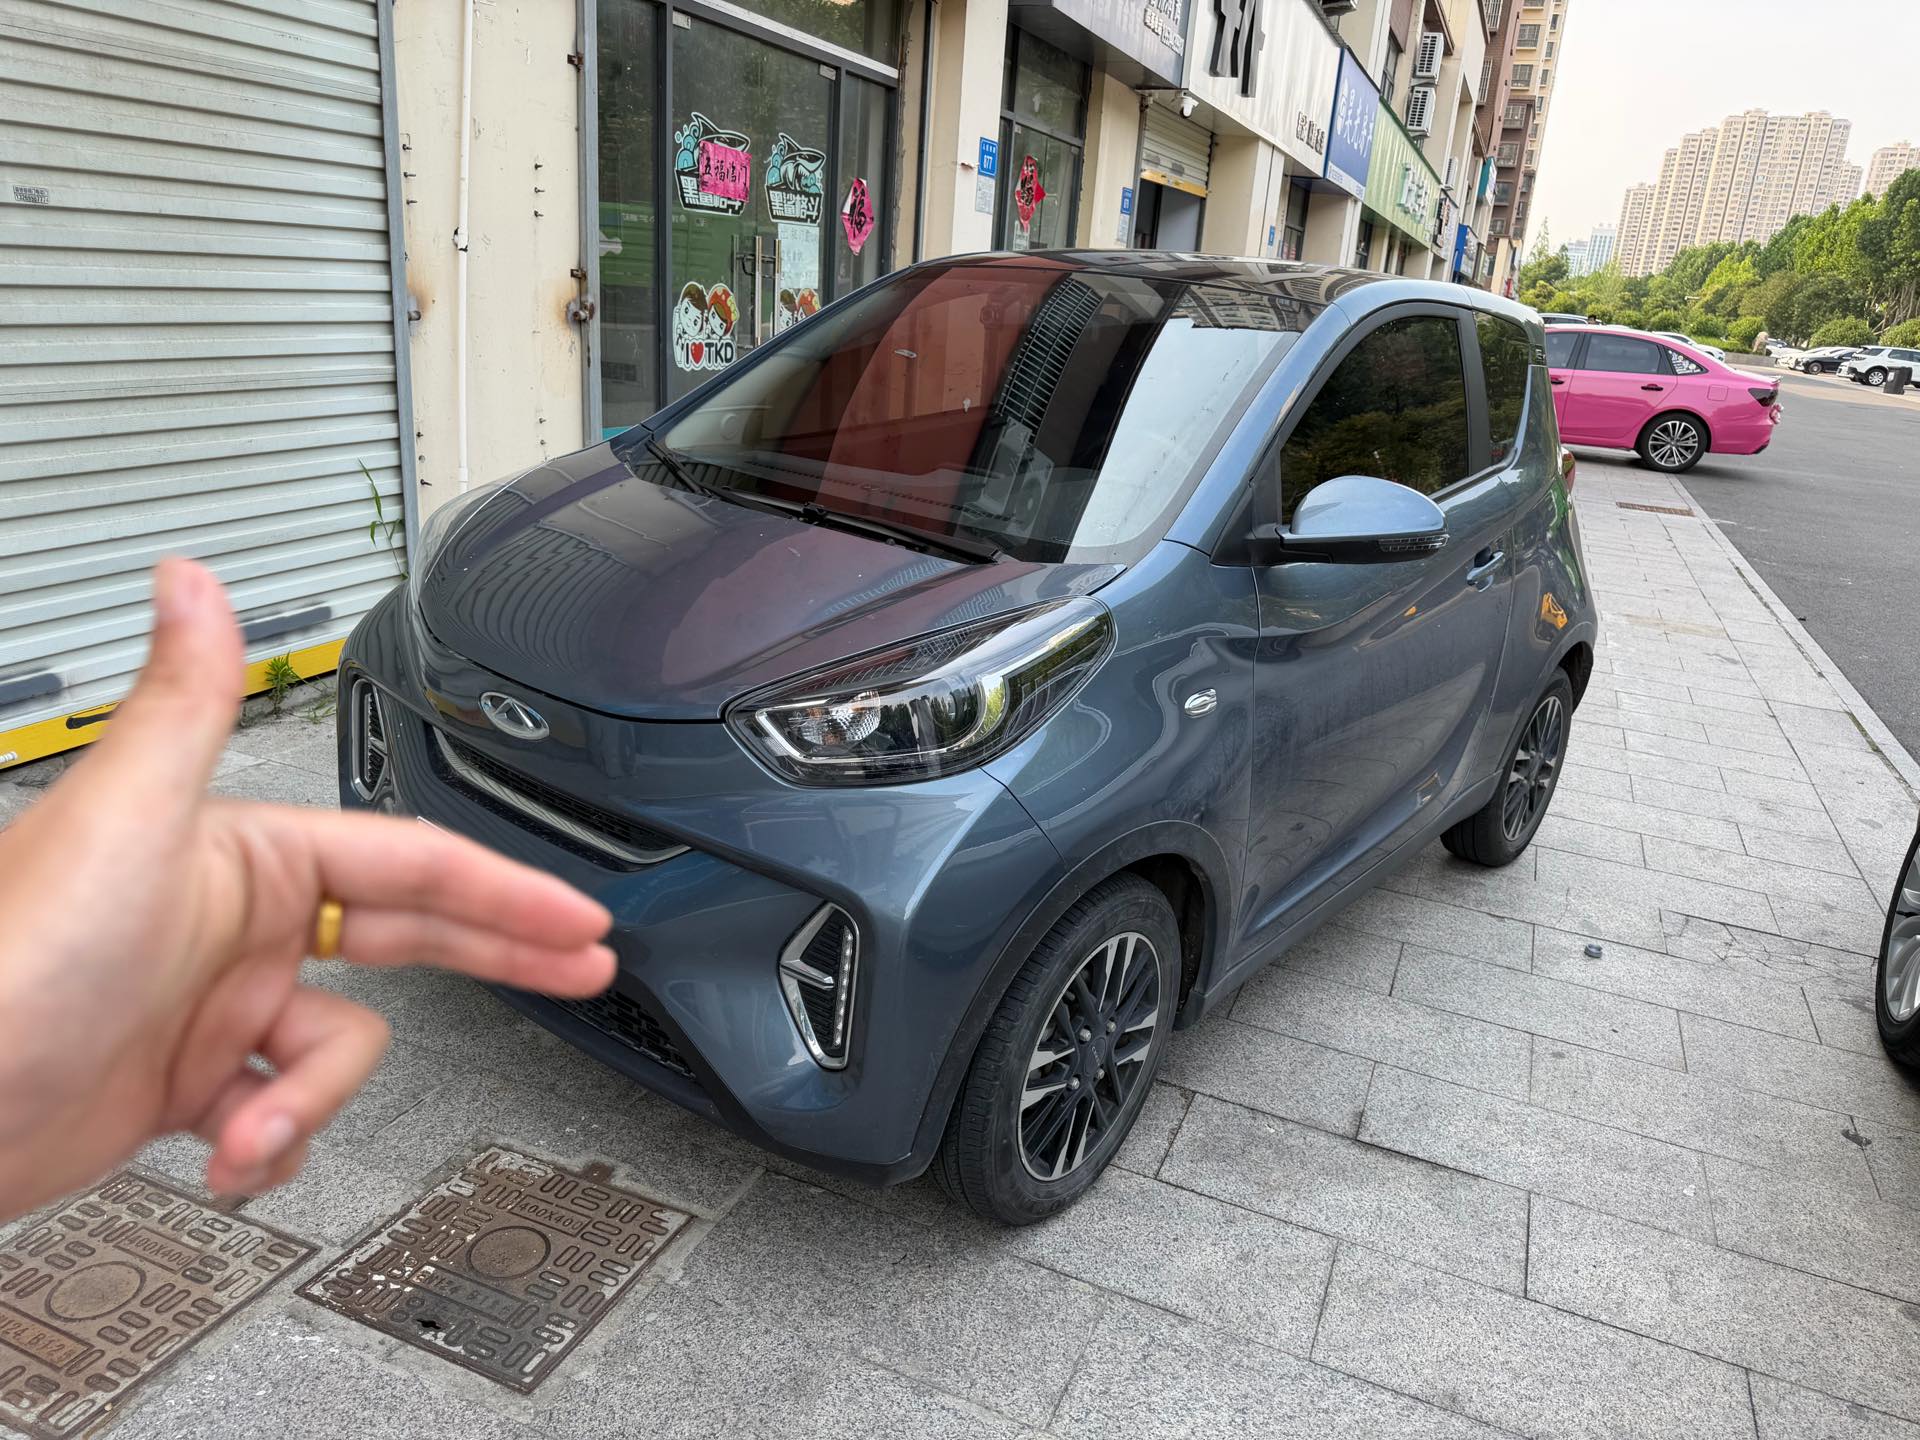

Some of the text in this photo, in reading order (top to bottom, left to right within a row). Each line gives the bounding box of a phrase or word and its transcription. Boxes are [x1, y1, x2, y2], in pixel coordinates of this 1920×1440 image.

[704, 157, 748, 185] 五福临门
[770, 190, 819, 221] 黑鲨格斗
[705, 342, 734, 364] TKD
